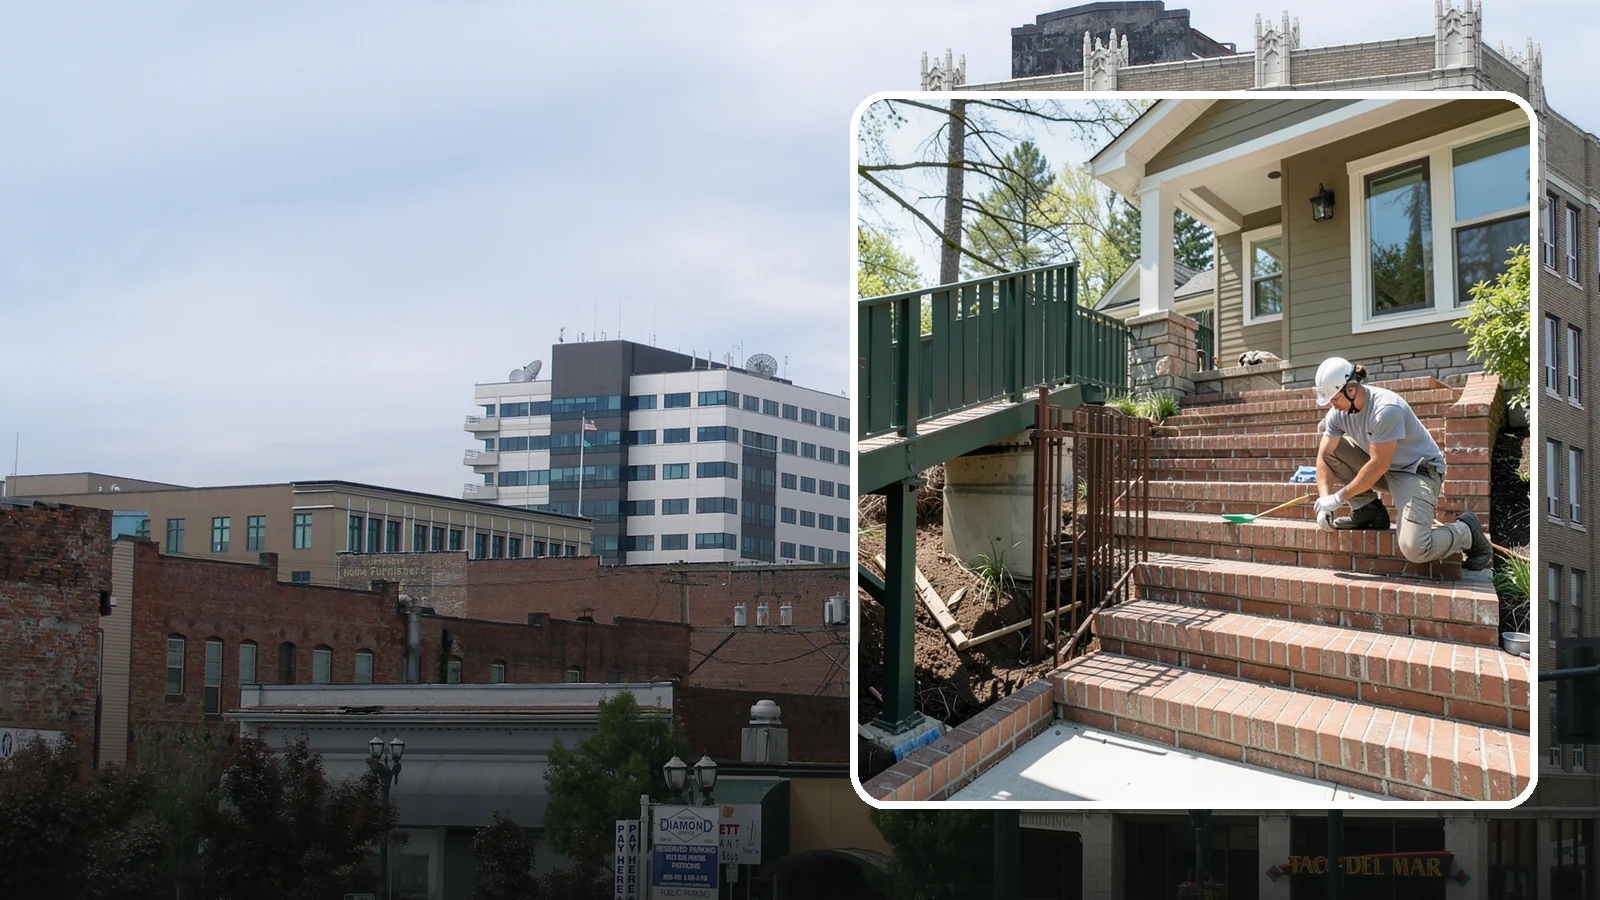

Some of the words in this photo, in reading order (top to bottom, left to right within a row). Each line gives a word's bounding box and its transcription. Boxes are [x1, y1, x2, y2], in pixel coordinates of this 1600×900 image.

[370, 565, 427, 577] Furnishers
[660, 818, 713, 832] DIAMOND
[1022, 815, 1071, 828] BUILDING
[617, 824, 625, 852] PAY
[721, 852, 739, 862] Soup
[1345, 856, 1385, 876] DEL
[1392, 857, 1443, 877] MAR
[617, 856, 625, 893] HERE
[628, 856, 636, 893] HERE
[660, 888, 682, 898] PUBLIC
[683, 890, 710, 899] PARKING
